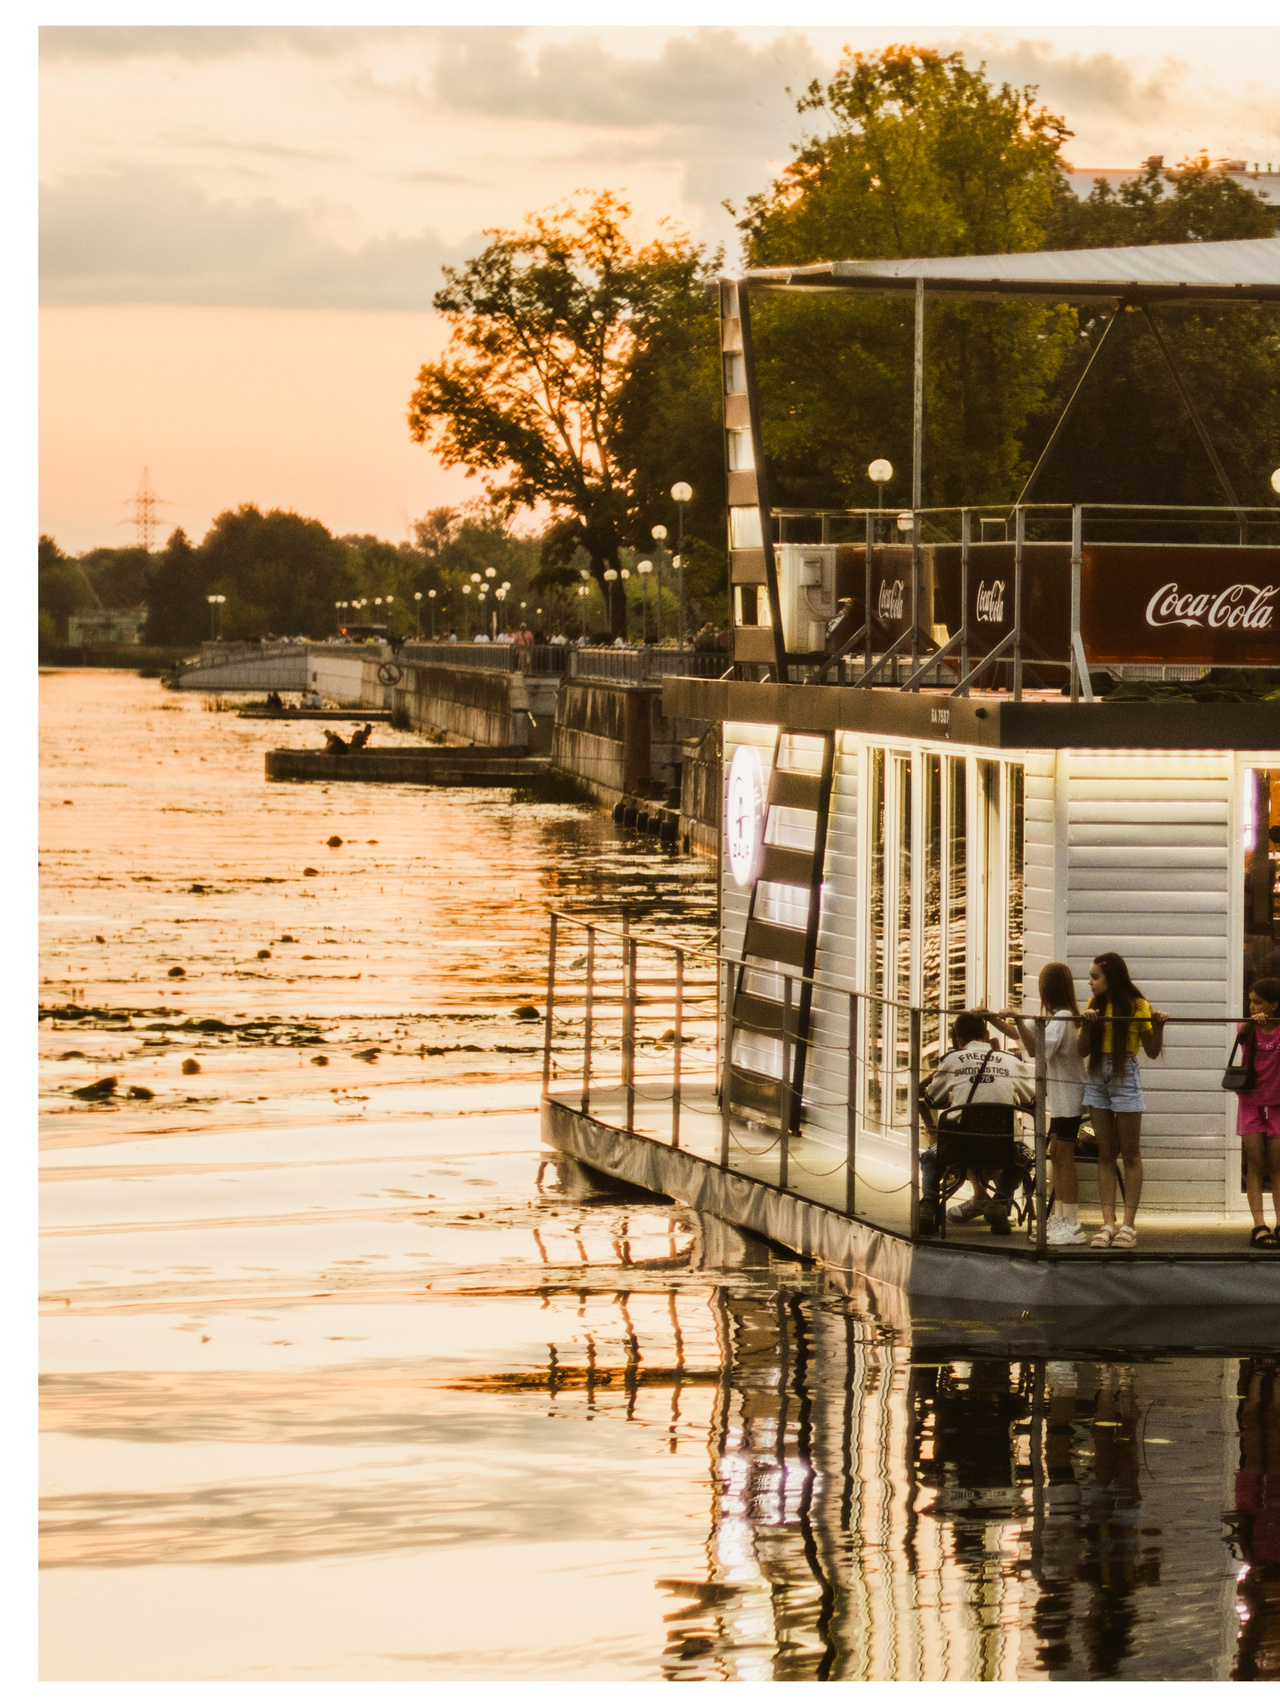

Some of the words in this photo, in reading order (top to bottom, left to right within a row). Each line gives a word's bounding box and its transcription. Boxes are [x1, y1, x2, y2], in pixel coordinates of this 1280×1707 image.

[878, 579, 904, 619] Coca-Cola
[976, 580, 1005, 622] Coca-Cola
[958, 1052, 1002, 1063] FREDDY
[954, 1066, 1010, 1077] GYMNSTICS
